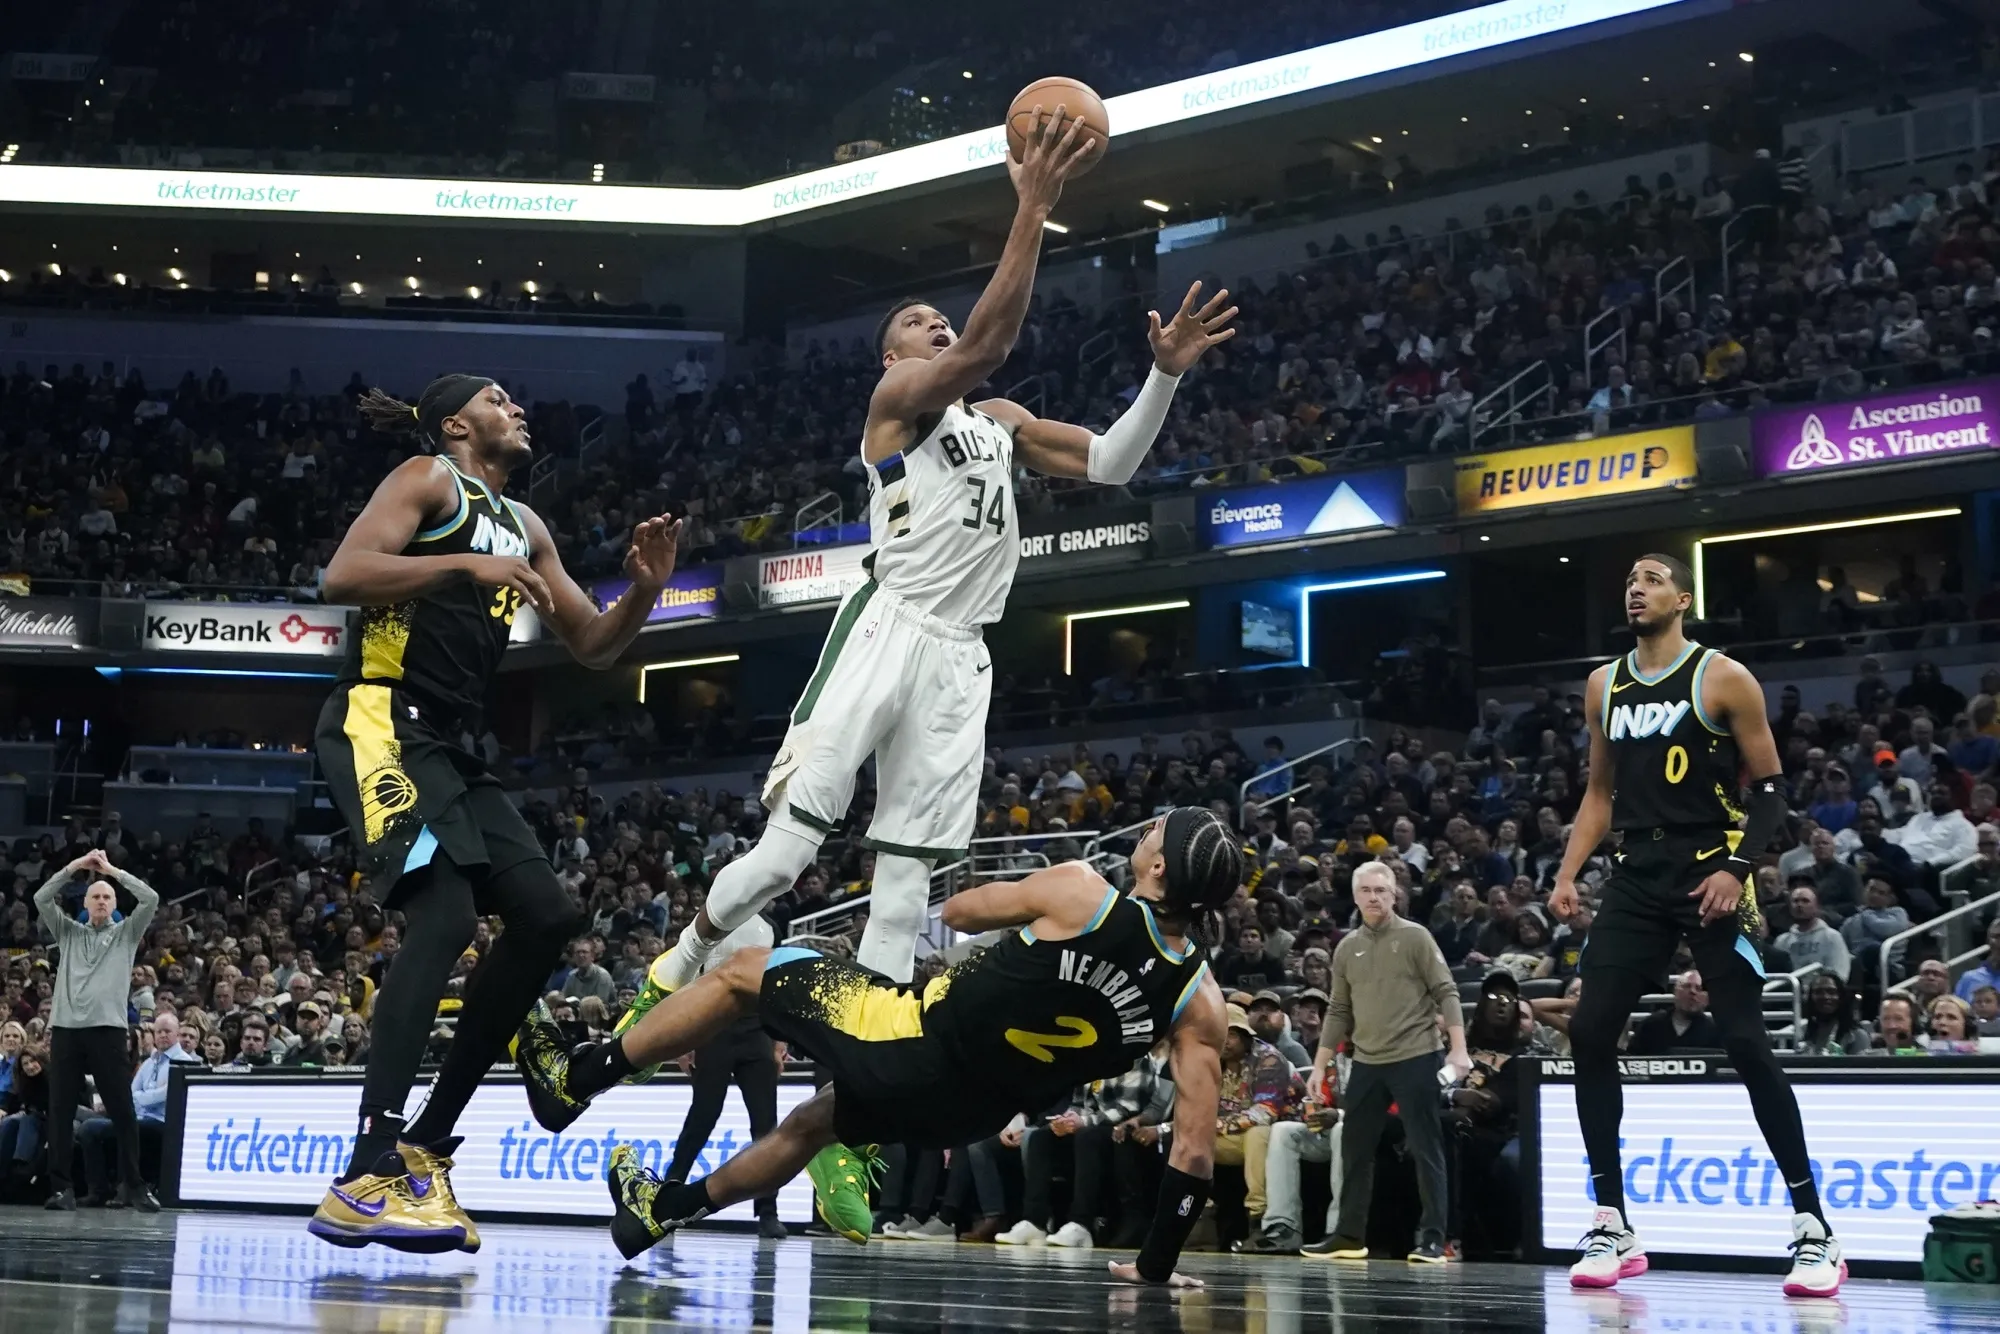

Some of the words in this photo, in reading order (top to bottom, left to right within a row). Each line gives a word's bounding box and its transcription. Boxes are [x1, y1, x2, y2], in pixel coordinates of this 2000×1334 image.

[1422, 1, 1570, 53] ticketmaster
[1181, 65, 1312, 111] ticketmaster
[157, 179, 301, 204] ticketmaster
[435, 189, 579, 214] ticketmaster
[773, 169, 879, 209] ticketmaster
[1848, 393, 1982, 430] Ascension
[1848, 436, 1885, 461] St.
[1884, 421, 1990, 456] Vincent
[1480, 459, 1592, 497] REVVED
[1598, 452, 1637, 481] UP
[962, 476, 1005, 535] 34
[1211, 502, 1283, 525] Elevance
[470, 512, 528, 557] INDY
[1020, 535, 1055, 558] ORT
[1060, 521, 1150, 553] GRAPHICS
[1244, 518, 1283, 534] Health
[762, 554, 824, 585] INDIANA
[661, 587, 717, 609] fitness
[761, 586, 805, 605] Members
[807, 580, 836, 598] Credit
[839, 577, 861, 596] Uni
[0, 610, 77, 636] Michelle
[146, 615, 272, 644] KeyBank
[1609, 700, 1691, 741] INDY
[1665, 745, 1689, 784] 0
[1058, 949, 1154, 1044] NEMBHARD
[1004, 1015, 1098, 1063] 2
[1650, 1060, 1707, 1075] BOLD
[206, 1117, 357, 1175] ticketm
[500, 1120, 753, 1183] ticketmst
[1583, 1138, 2000, 1212] cketmaster
